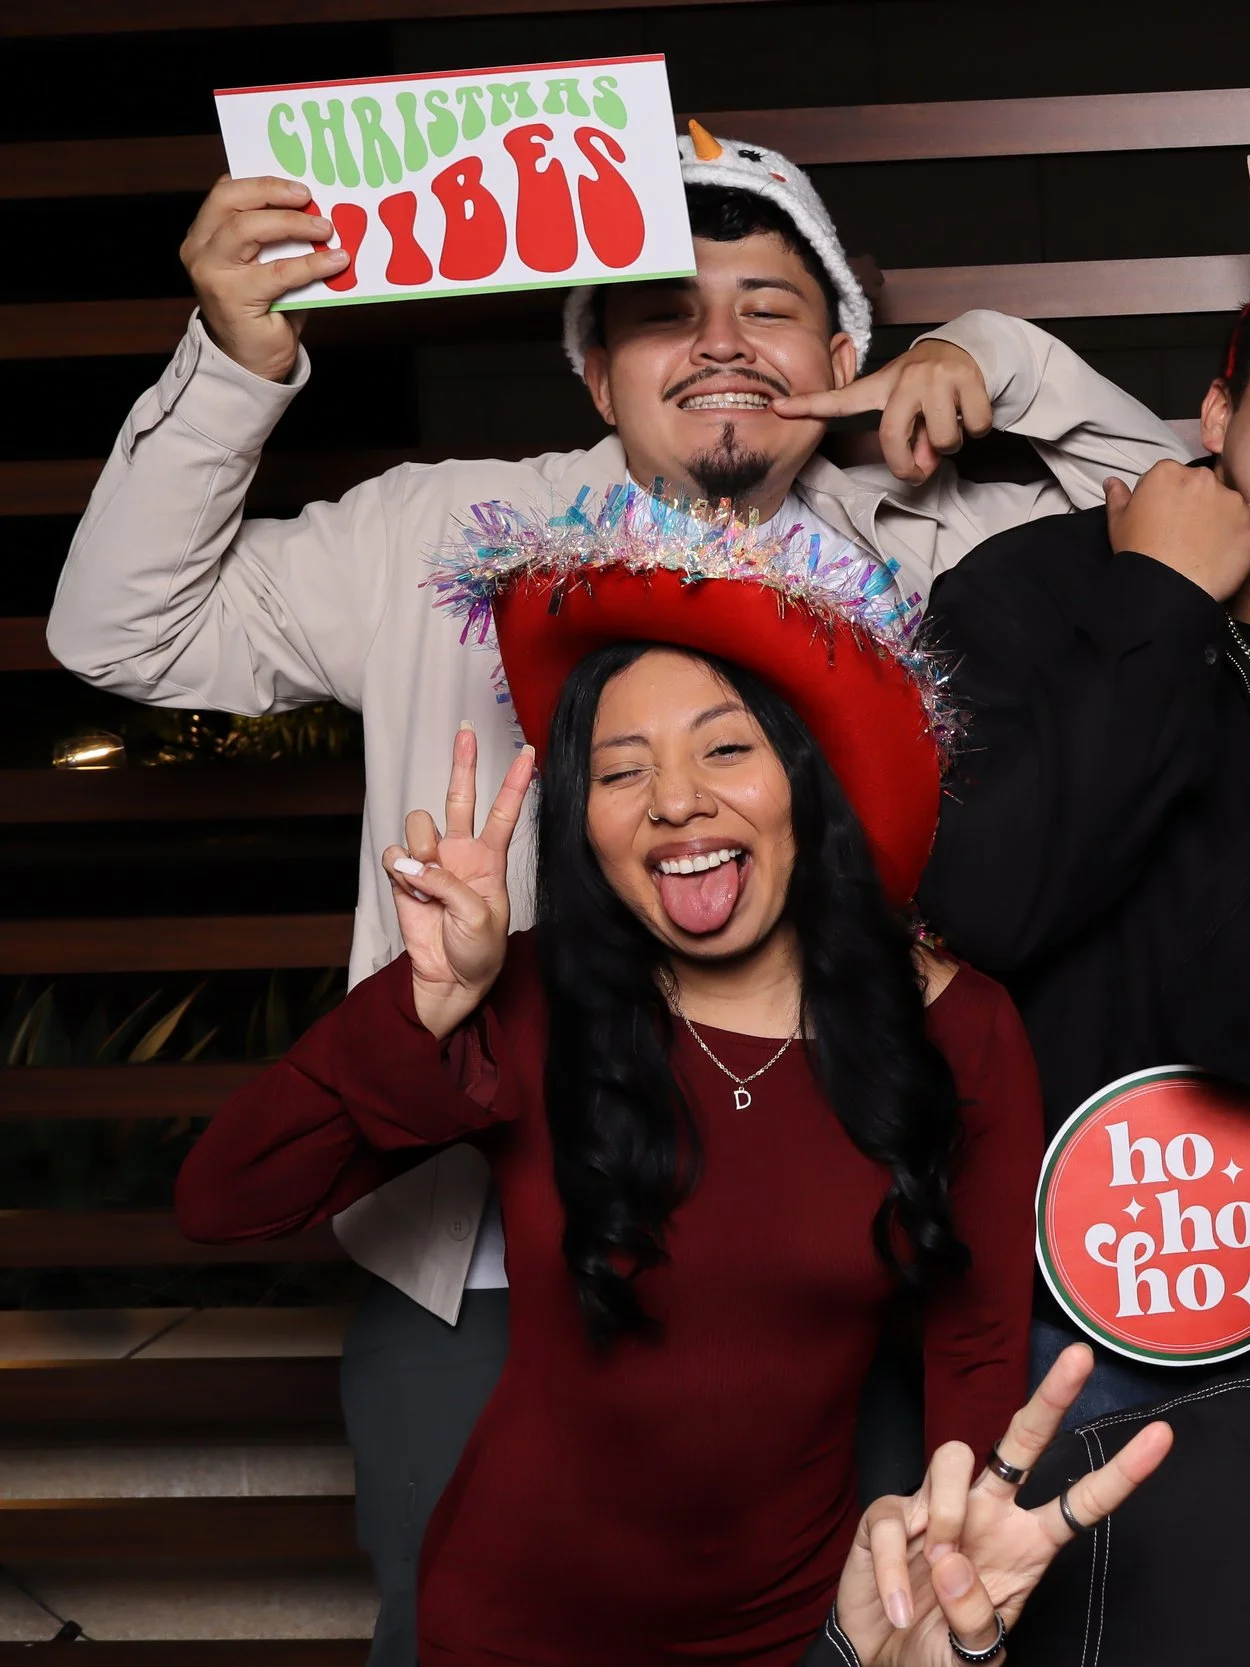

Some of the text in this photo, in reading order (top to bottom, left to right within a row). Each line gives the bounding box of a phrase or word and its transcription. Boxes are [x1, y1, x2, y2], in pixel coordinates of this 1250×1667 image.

[267, 75, 628, 189] CHRISTMAS
[303, 123, 646, 292] VIBES
[733, 1090, 752, 1110] D
[1105, 1121, 1214, 1187] ho
[1084, 1223, 1226, 1318] ho
